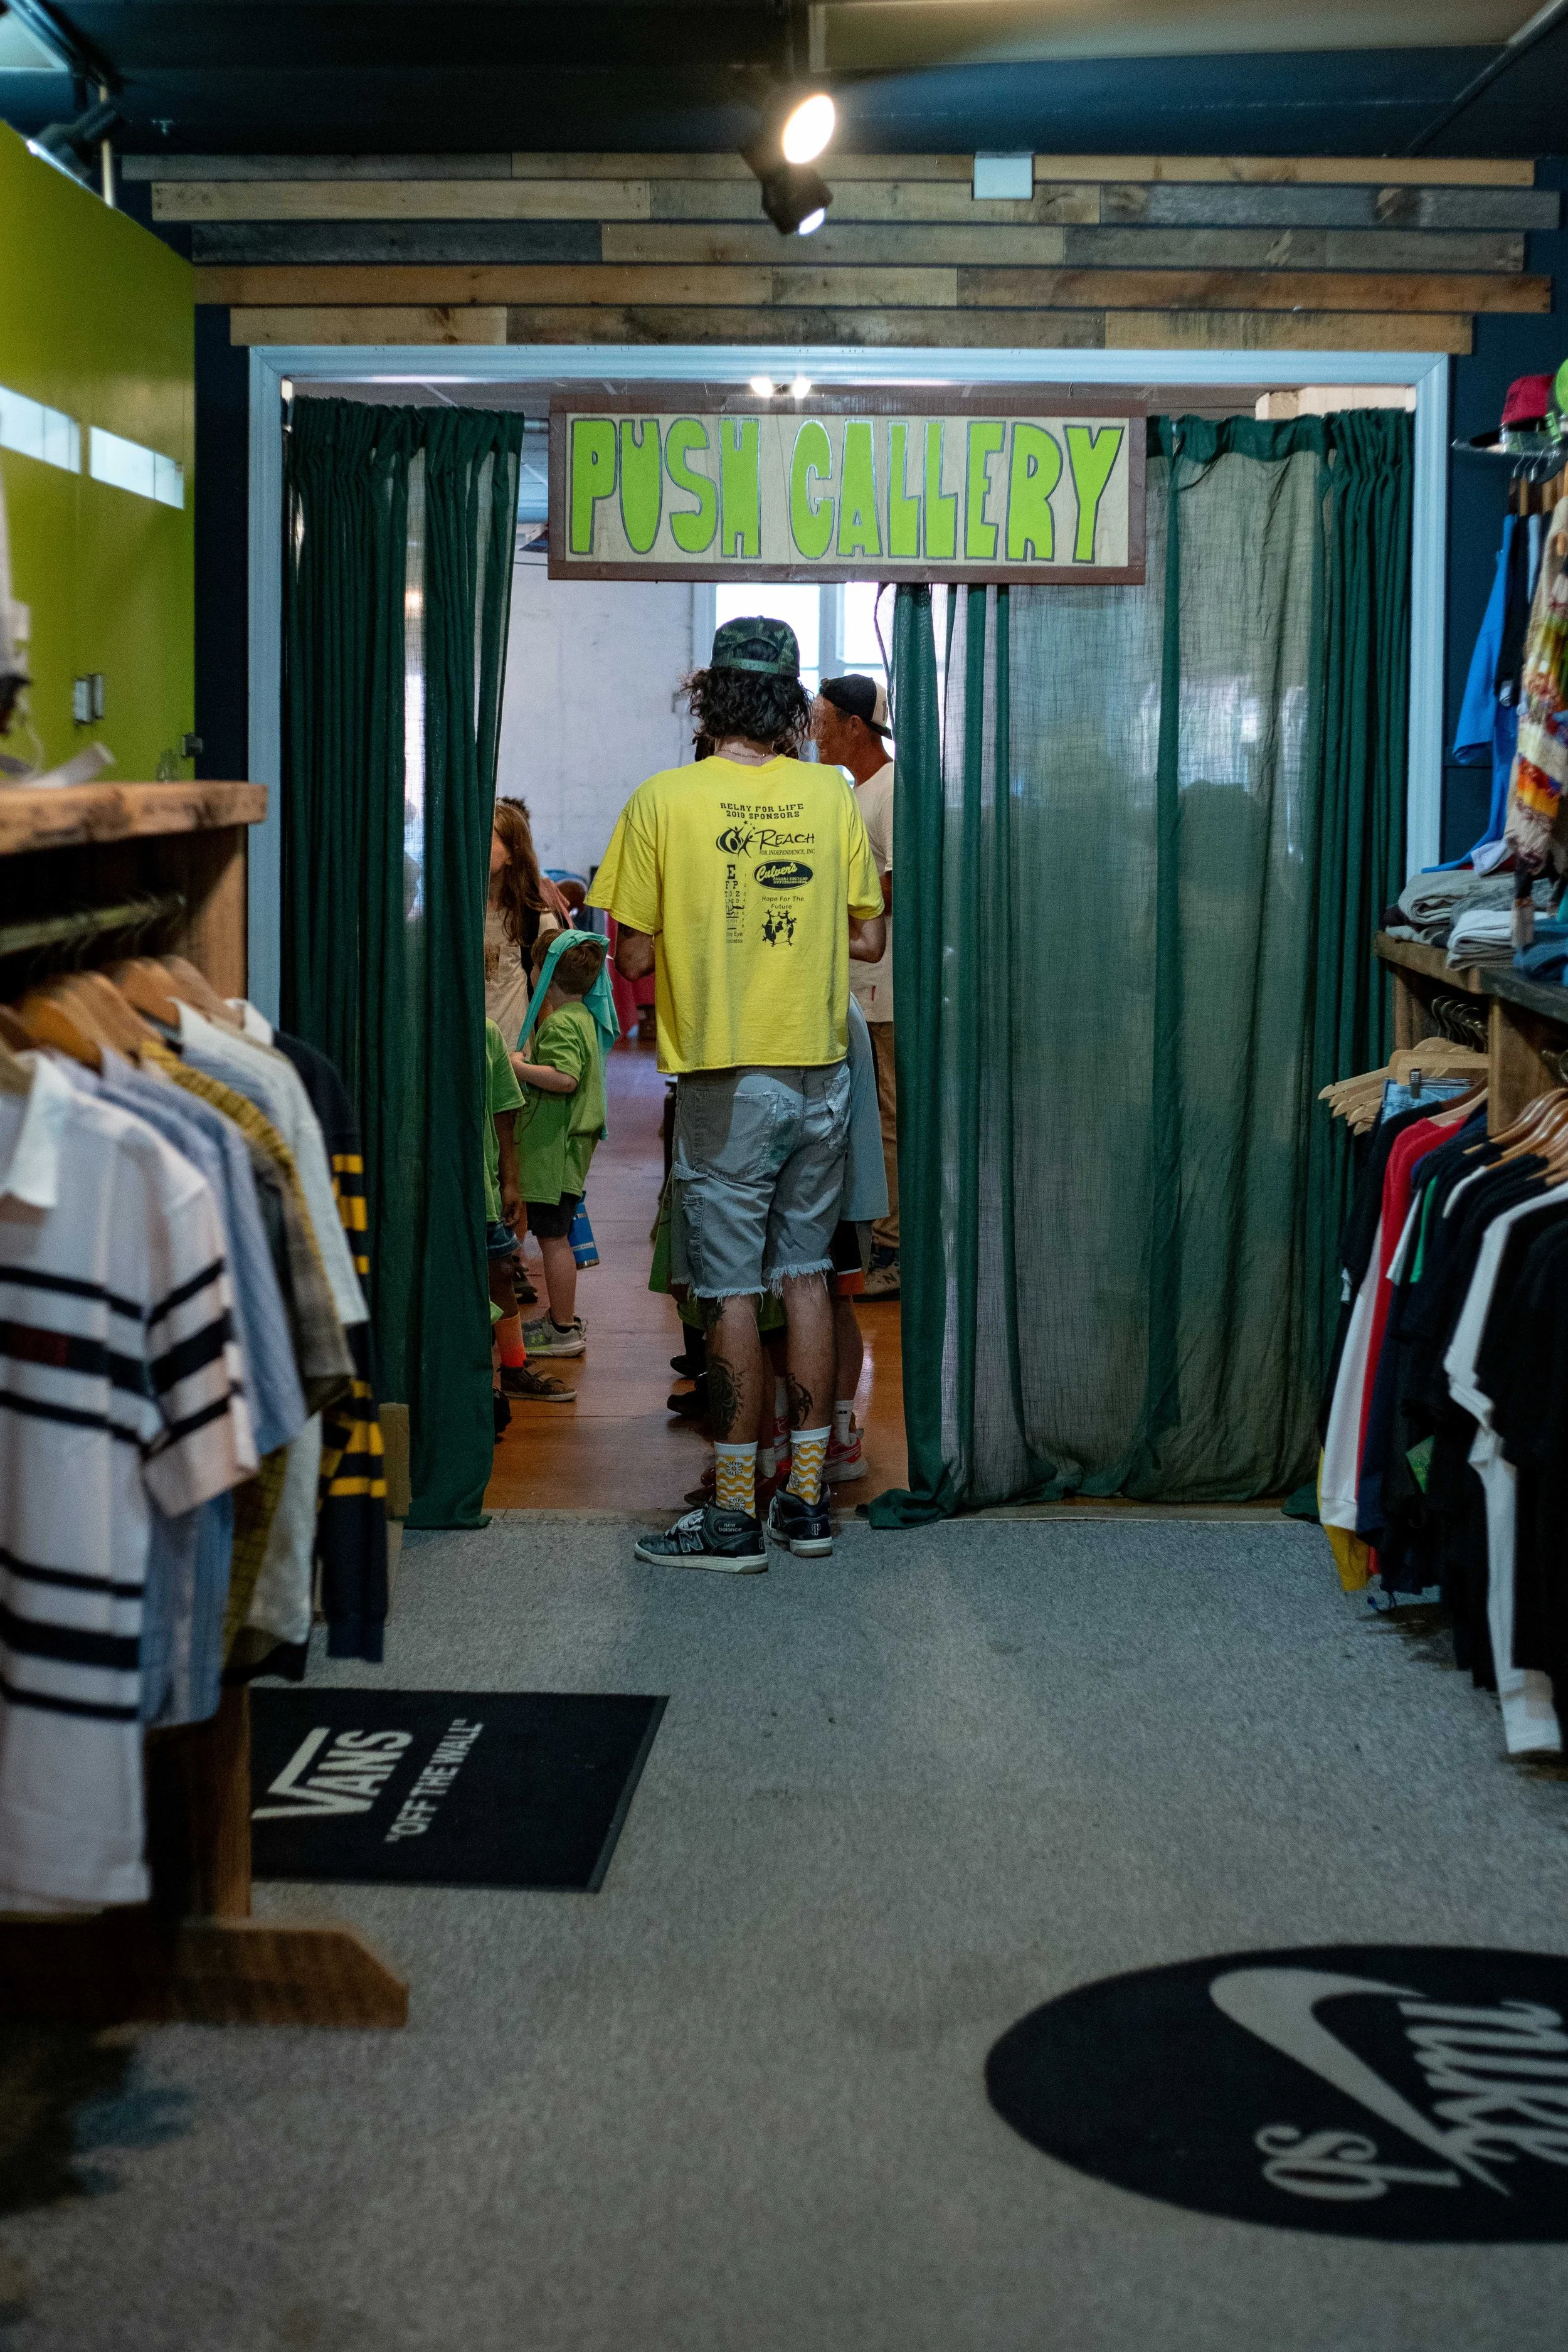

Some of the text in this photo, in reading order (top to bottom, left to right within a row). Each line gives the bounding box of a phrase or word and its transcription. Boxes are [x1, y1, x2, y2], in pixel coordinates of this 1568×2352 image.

[570, 417, 1125, 564] PUSH GALLERY
[720, 802, 751, 812] RELAY
[778, 803, 804, 812] LIFE
[749, 811, 800, 820] SPONSORS
[727, 864, 736, 879] E
[756, 862, 798, 882] Culver's
[250, 1727, 413, 1821] VANS
[408, 1766, 460, 1797] THE
